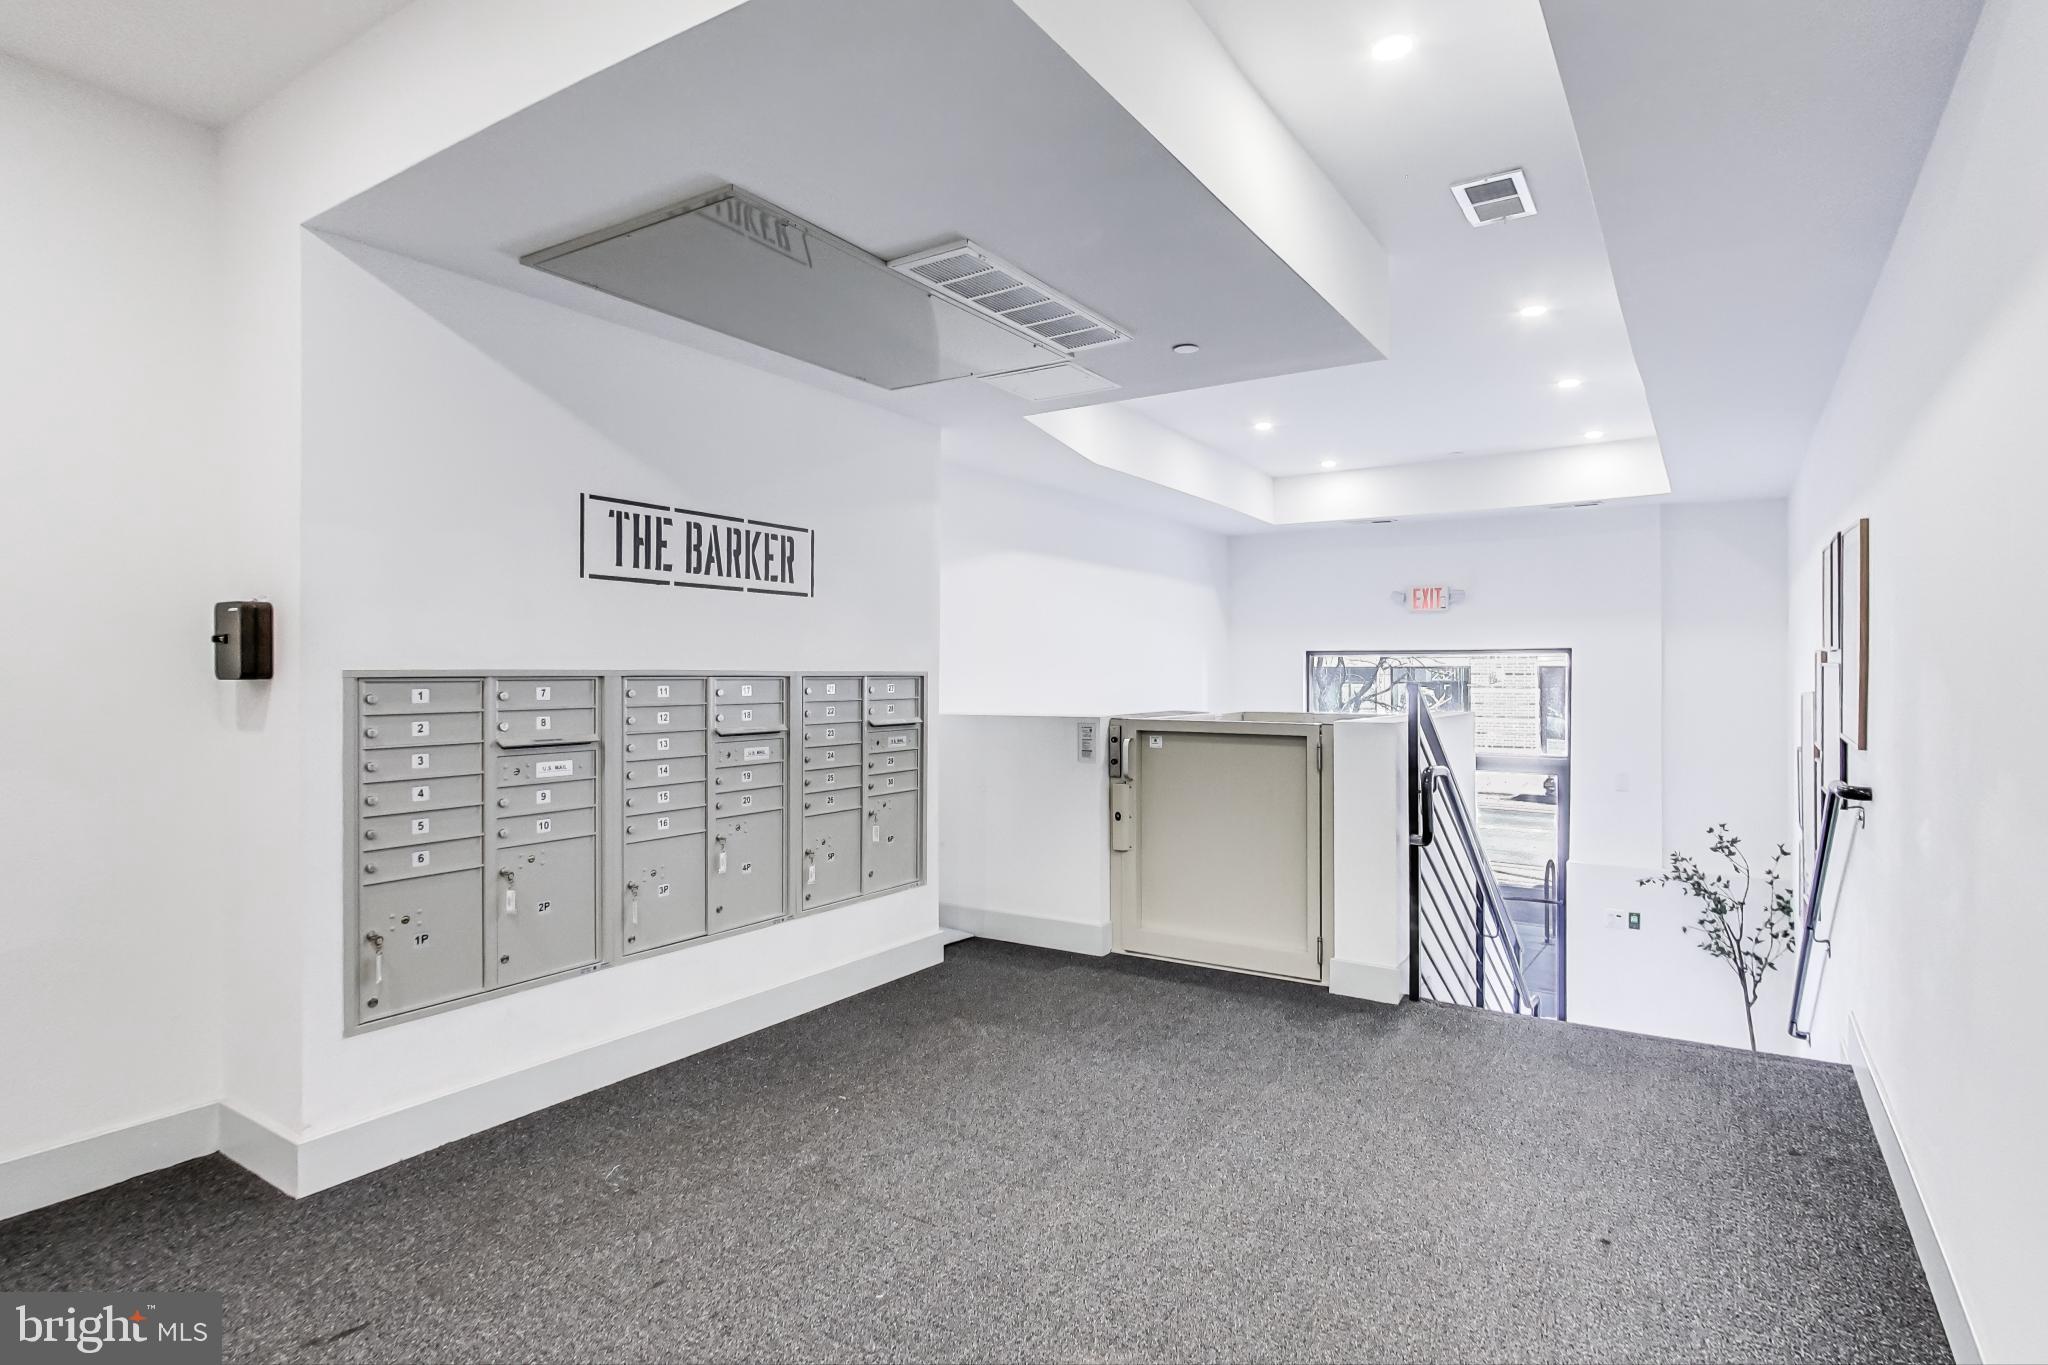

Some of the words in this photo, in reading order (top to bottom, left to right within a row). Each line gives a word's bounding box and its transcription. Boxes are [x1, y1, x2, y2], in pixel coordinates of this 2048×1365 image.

[608, 509, 673, 572] THE
[685, 521, 795, 584] BARKER
[1413, 587, 1442, 609] EXIT
[540, 689, 547, 698] 7
[659, 687, 668, 695] 11
[417, 691, 424, 701] 1
[659, 713, 668, 721] 12
[540, 718, 547, 728] 8
[417, 724, 424, 734] 2
[659, 740, 668, 748] 13
[417, 756, 424, 766] 3
[659, 766, 668, 774] 14
[743, 772, 751, 780] 19
[827, 774, 834, 782] 25
[417, 789, 424, 798] 4
[540, 792, 547, 801] 9
[659, 792, 668, 801] 15
[742, 796, 751, 804] 20
[417, 821, 424, 831] 5
[538, 821, 550, 830] 10
[659, 819, 668, 827] 16
[417, 853, 425, 863] 6
[742, 863, 751, 871] 4P
[659, 885, 669, 895] 3P
[538, 901, 551, 912] 2P
[414, 934, 429, 945] 1P
